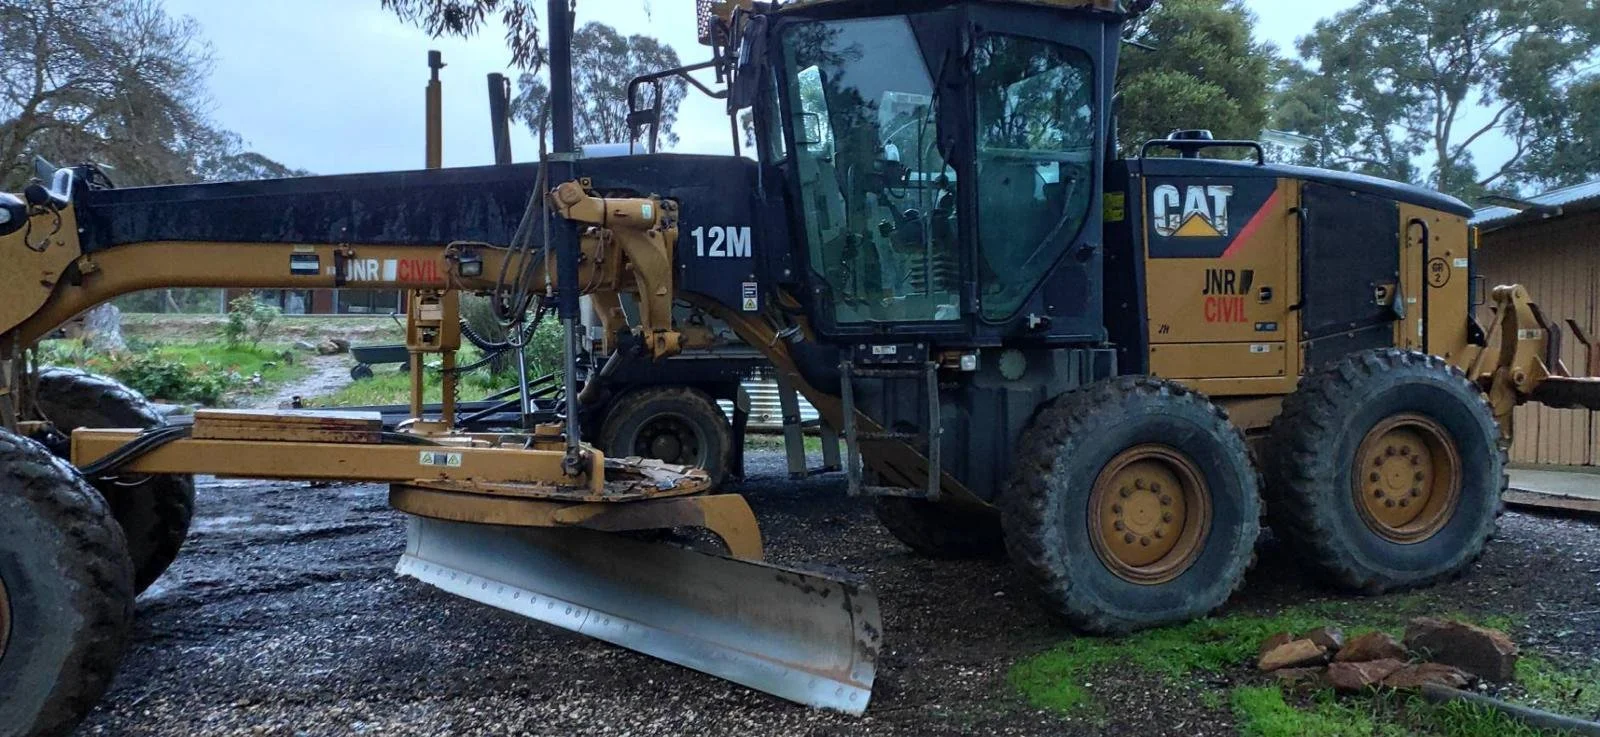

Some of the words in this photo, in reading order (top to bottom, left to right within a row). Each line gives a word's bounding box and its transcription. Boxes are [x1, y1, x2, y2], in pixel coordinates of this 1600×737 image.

[1153, 185, 1232, 236] CAT
[691, 226, 752, 257] 12M
[345, 259, 379, 281] JNR
[398, 260, 441, 281] CIVIL
[1202, 269, 1236, 294] JNR
[1204, 296, 1248, 322] CIVIL
